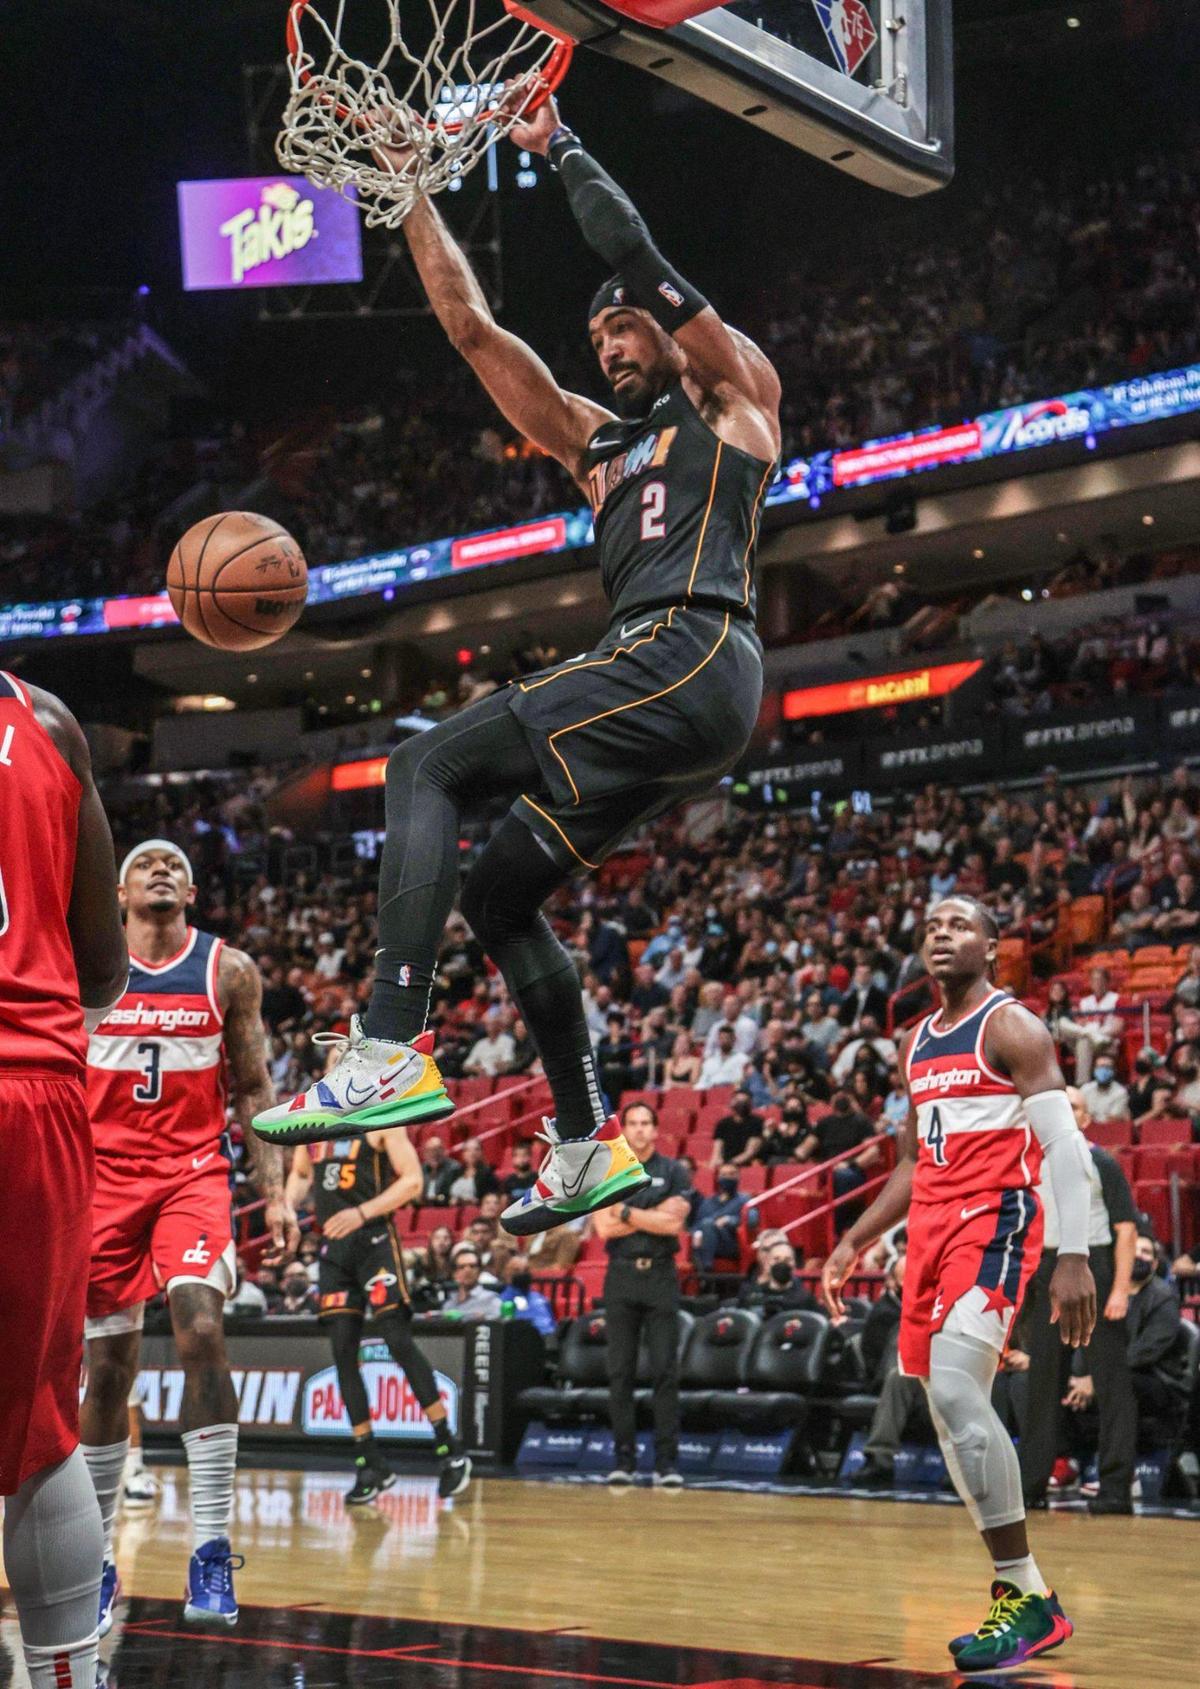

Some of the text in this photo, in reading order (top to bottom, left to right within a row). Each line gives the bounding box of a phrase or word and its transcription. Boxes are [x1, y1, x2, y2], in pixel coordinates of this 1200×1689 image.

[219, 199, 314, 284] Takis
[640, 480, 667, 541] 2
[133, 1042, 162, 1103] 3
[910, 1067, 981, 1094] ashington
[925, 1104, 949, 1166] 4
[322, 1162, 357, 1191] 55
